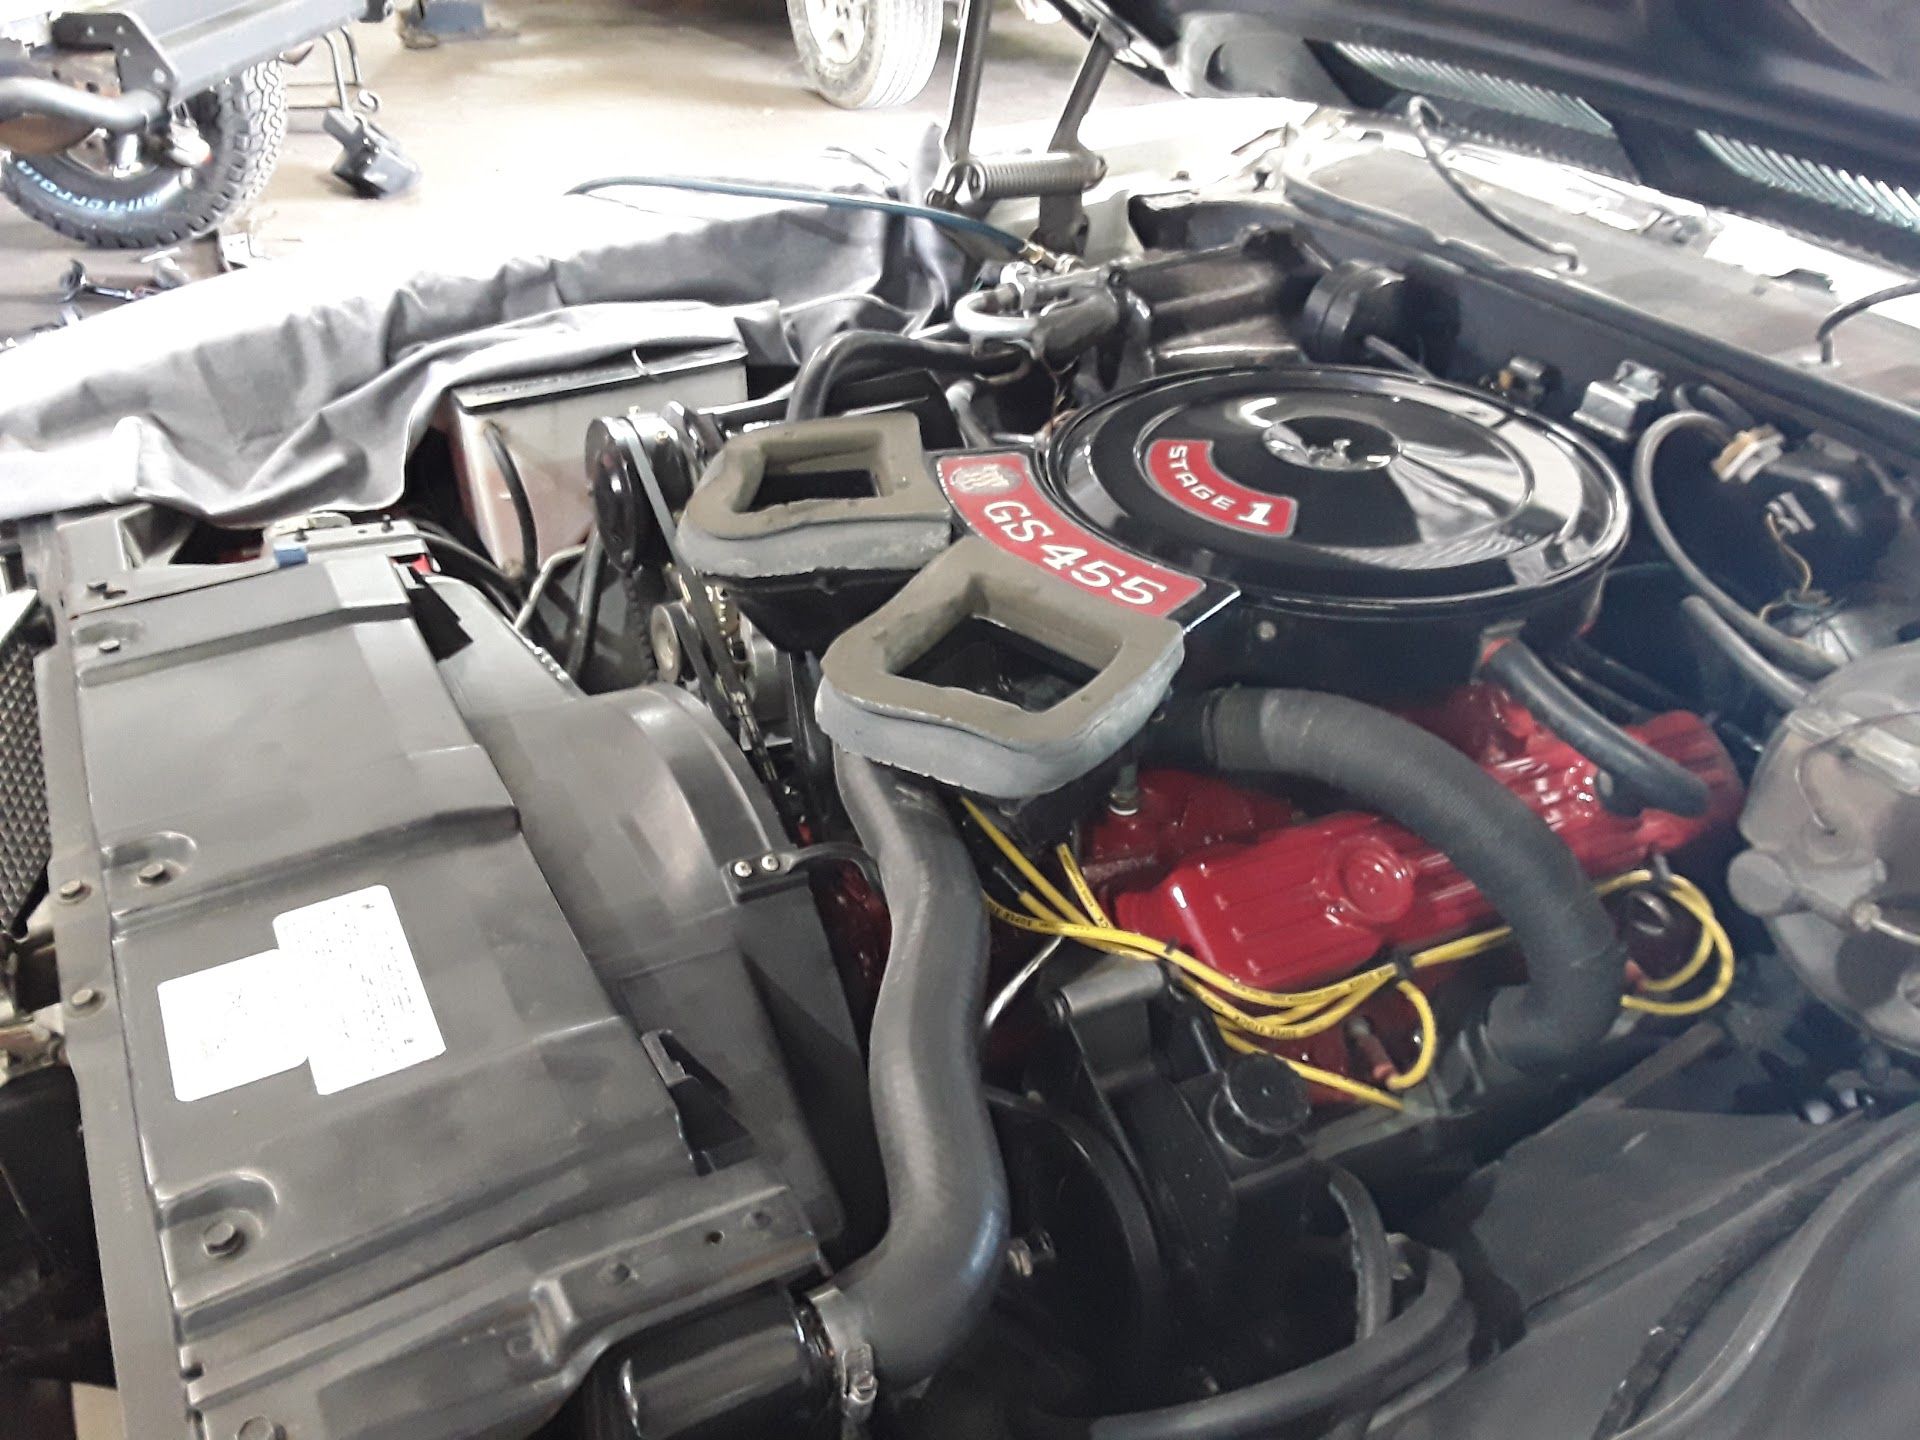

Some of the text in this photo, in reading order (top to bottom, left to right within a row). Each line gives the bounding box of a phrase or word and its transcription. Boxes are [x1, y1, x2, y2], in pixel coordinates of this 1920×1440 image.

[1168, 445, 1274, 526] STAGE 1
[984, 501, 1167, 605] GS 455
